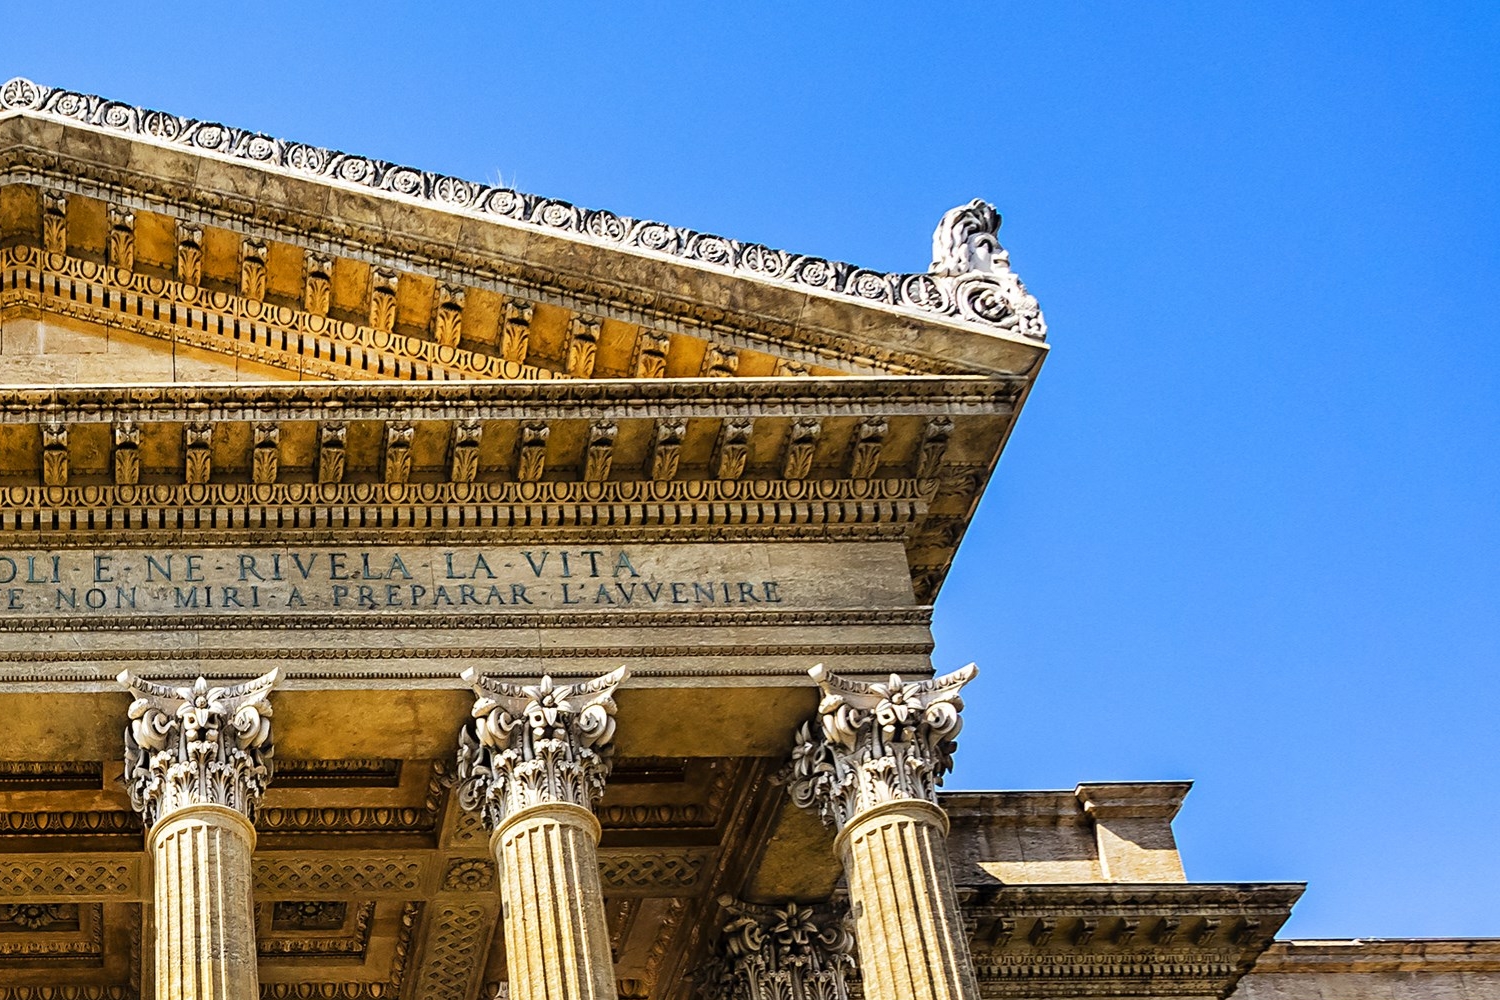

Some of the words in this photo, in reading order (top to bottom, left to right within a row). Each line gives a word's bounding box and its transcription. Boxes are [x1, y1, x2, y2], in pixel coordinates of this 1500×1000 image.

[94, 555, 115, 583] E
[144, 554, 205, 583] NE
[237, 552, 414, 582] RIVELA
[444, 552, 498, 580] LA
[520, 550, 641, 578] VITA
[55, 586, 137, 609] NON
[173, 585, 262, 608] MIRI
[285, 584, 308, 607] A
[332, 582, 534, 608] PREPARAR
[562, 581, 784, 605] L'AVVENIRE
